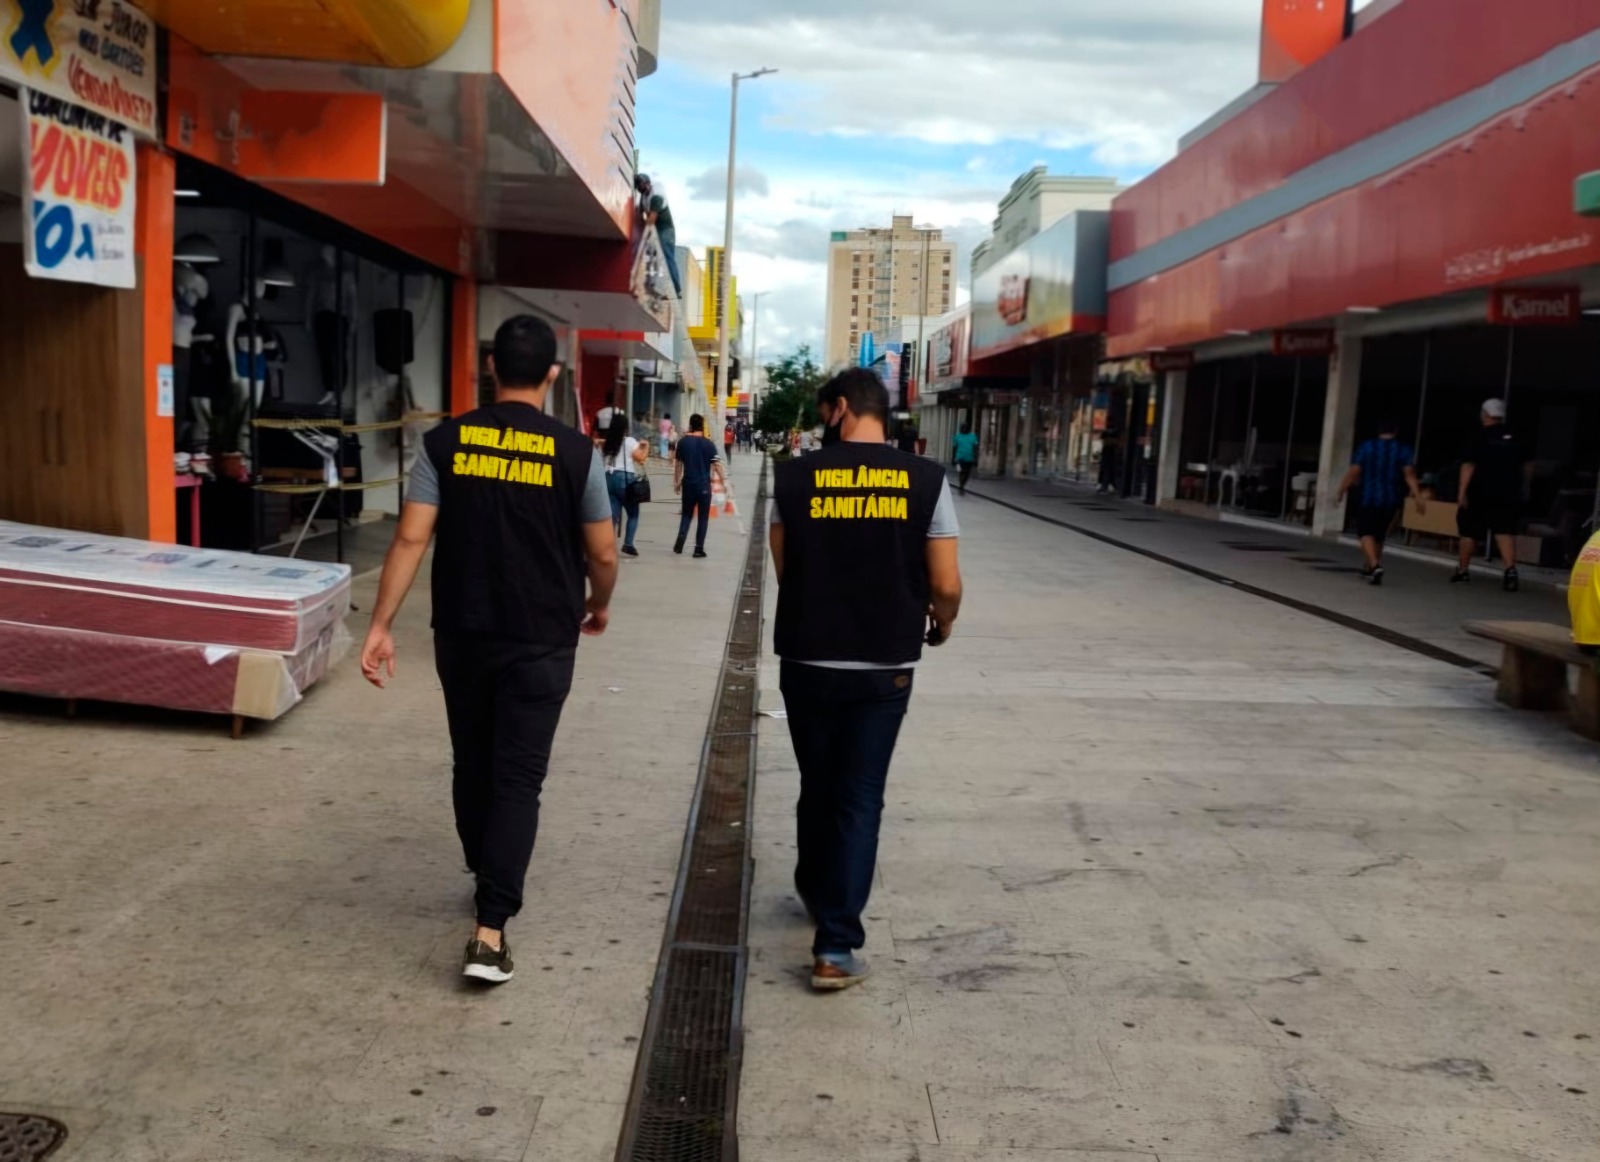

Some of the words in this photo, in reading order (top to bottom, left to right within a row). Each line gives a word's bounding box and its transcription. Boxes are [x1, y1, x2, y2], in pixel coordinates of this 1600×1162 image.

[452, 452, 553, 487] SANITÁRIA
[814, 464, 910, 489] VIGILÂNCIA
[809, 493, 909, 520] SANITÁRIA
